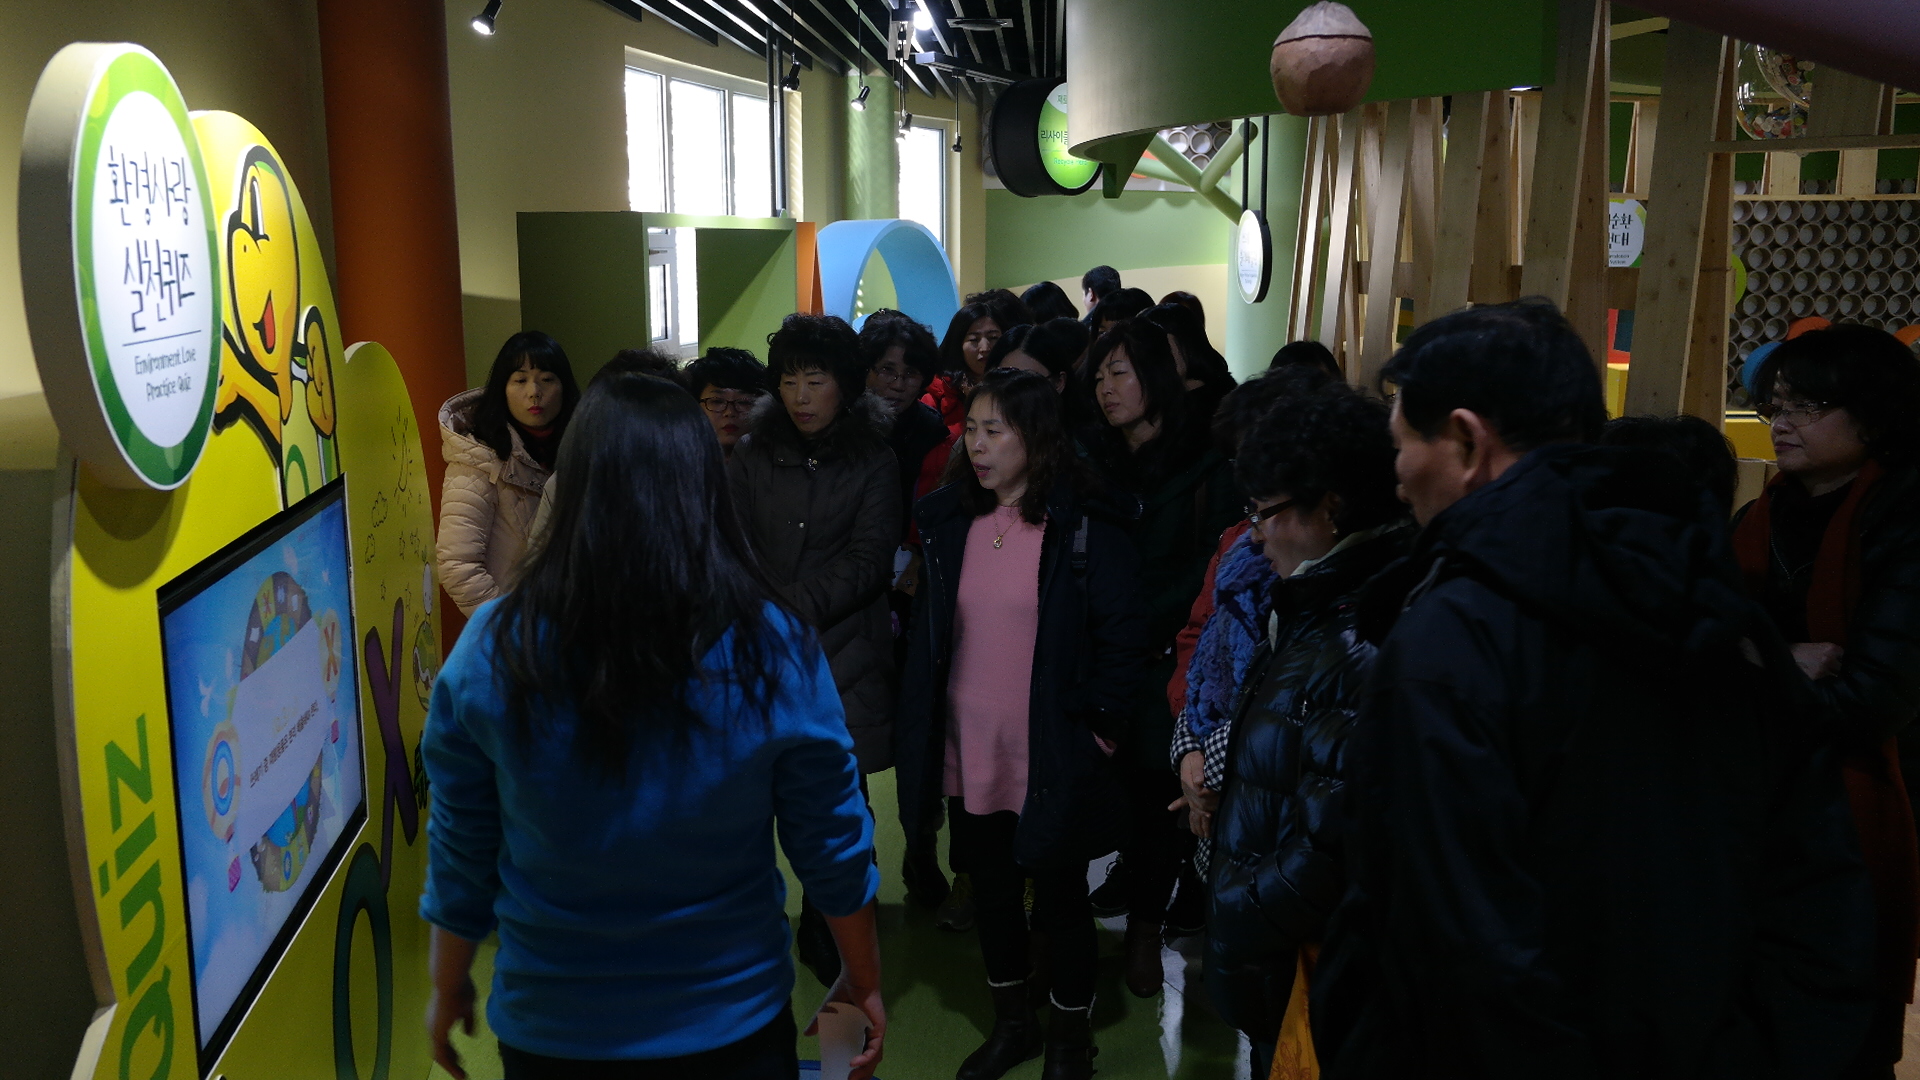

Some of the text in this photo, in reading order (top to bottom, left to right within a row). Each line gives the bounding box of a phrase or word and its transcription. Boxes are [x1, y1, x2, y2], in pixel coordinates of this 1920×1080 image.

[108, 144, 192, 226] 환경사랑
[1609, 213, 1633, 229] 순환
[124, 238, 195, 333] 실천퀴즈
[135, 346, 196, 375] Environment Love
[146, 372, 191, 401] Practice Quiz
